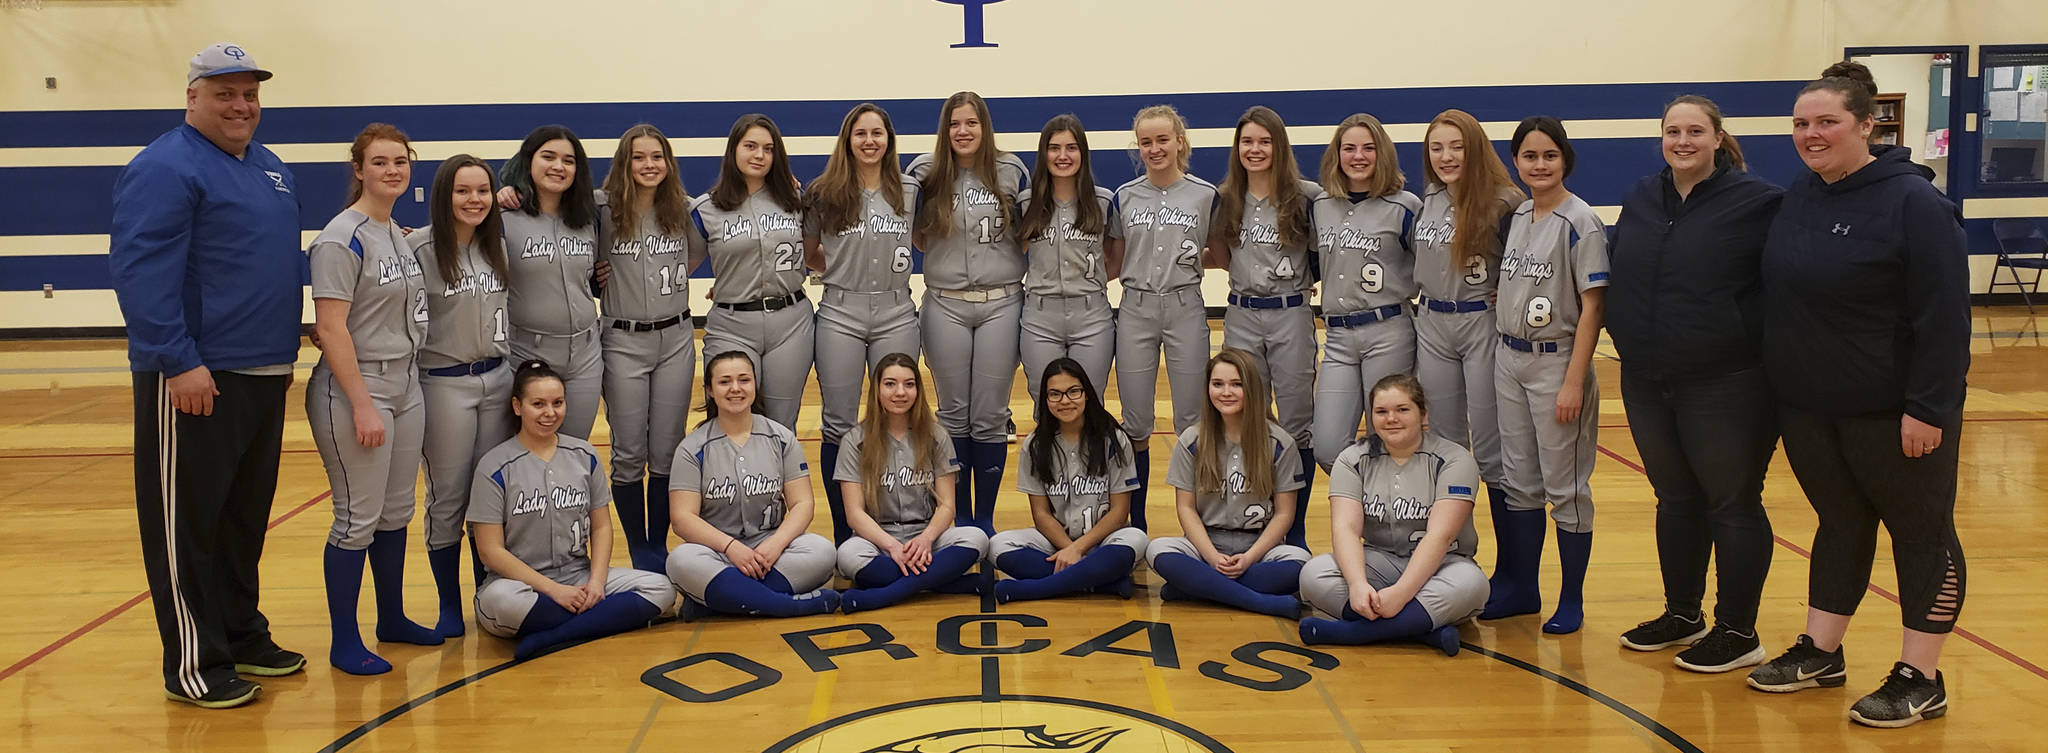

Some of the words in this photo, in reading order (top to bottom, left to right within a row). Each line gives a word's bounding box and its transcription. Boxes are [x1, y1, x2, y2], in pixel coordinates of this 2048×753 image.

[724, 215, 752, 244] Lady
[870, 214, 909, 241] Vikings
[1127, 207, 1155, 231] Lady
[1158, 206, 1198, 234] Vikings
[521, 235, 556, 264] Lady
[610, 238, 642, 262] Lady
[775, 241, 804, 272] 27
[1176, 239, 1199, 267] 2
[1339, 228, 1381, 258] Vikings
[891, 245, 912, 274] 6
[1085, 252, 1097, 279] 1
[1274, 256, 1295, 280] 4
[1464, 254, 1488, 286] 3
[659, 262, 688, 296] 14
[1360, 262, 1385, 294] 9
[412, 287, 430, 324] 2
[1526, 296, 1553, 328] 8
[493, 307, 506, 342] 1
[512, 488, 548, 519] Lady
[705, 475, 737, 506] Lady
[640, 613, 1341, 703] ORCAS
